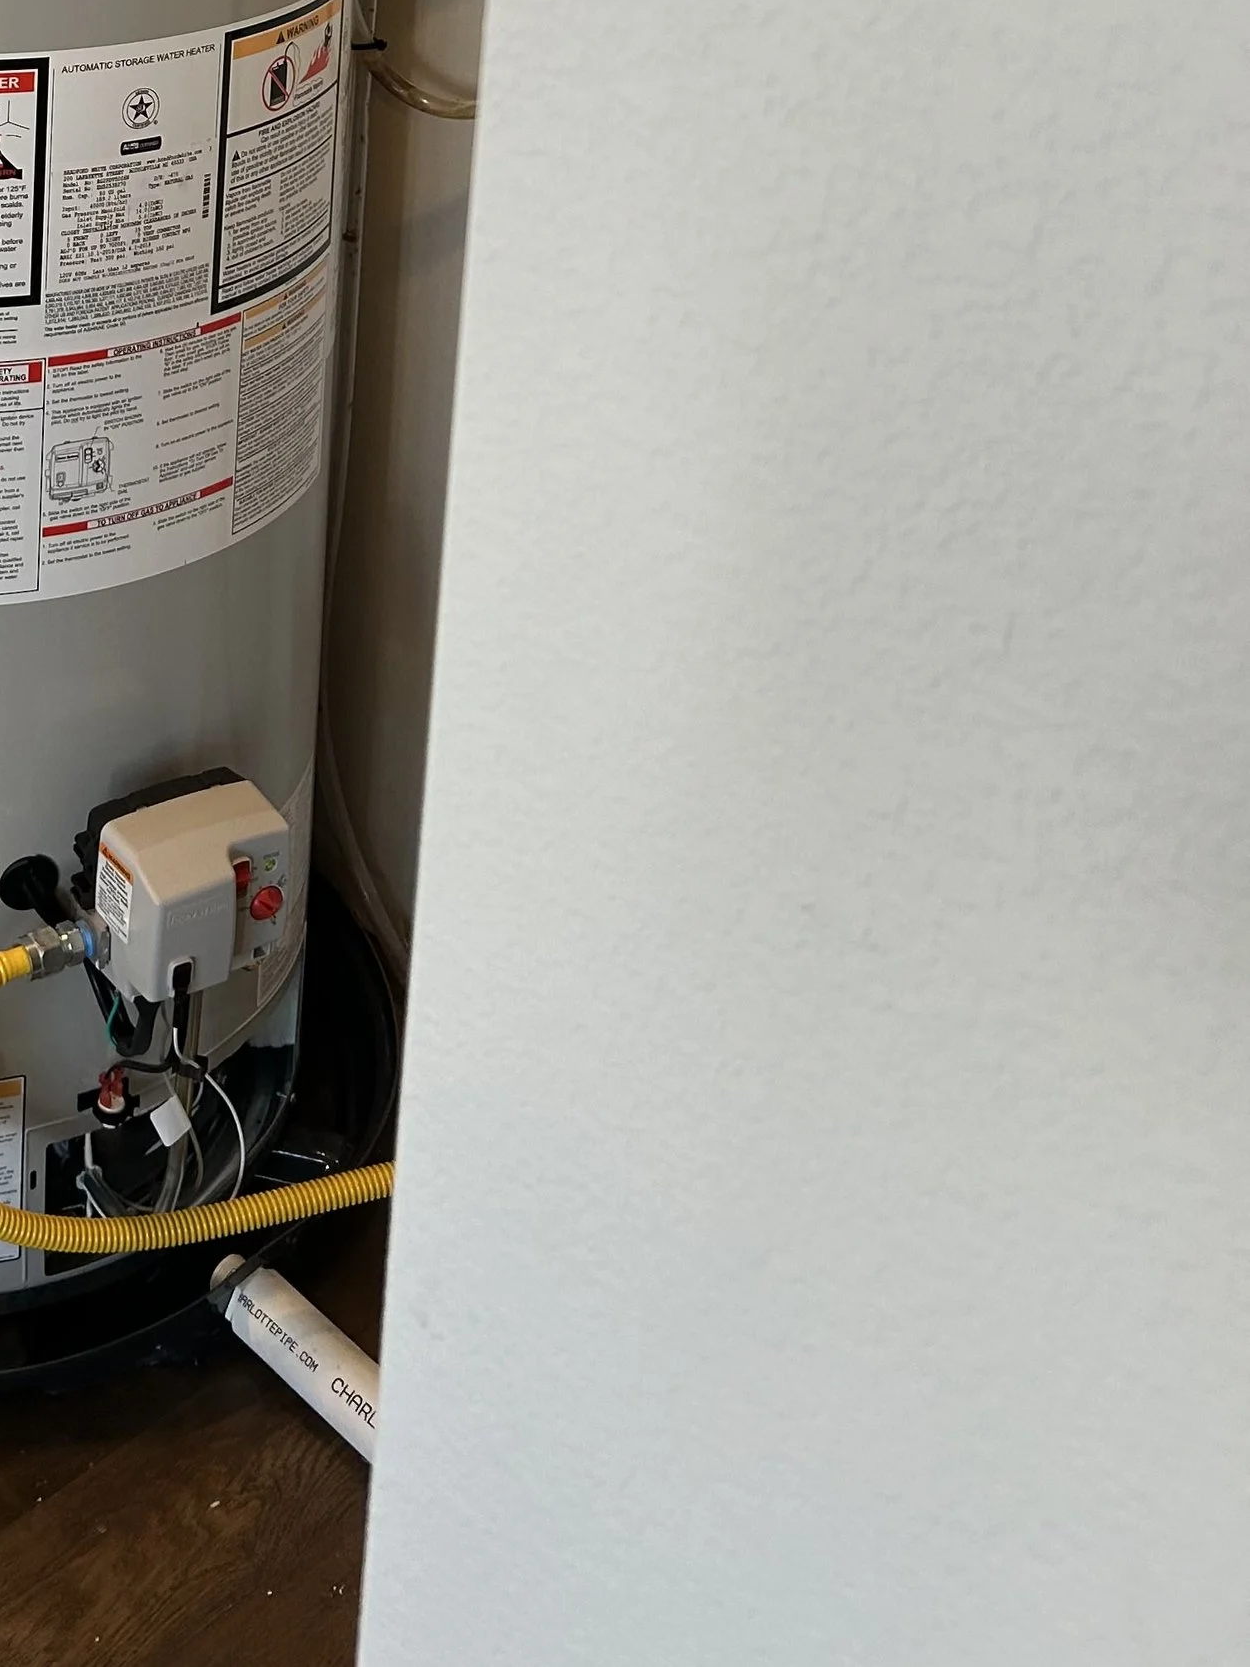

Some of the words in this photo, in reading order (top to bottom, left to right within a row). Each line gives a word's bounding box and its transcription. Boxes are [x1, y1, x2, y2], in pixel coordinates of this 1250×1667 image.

[286, 15, 319, 39] WARNING
[62, 61, 113, 74] AUTOMATIC
[115, 55, 154, 68] STORAGE
[157, 50, 184, 62] WATER
[186, 44, 215, 56] HEATER
[114, 341, 150, 356] OPERATING
[153, 331, 196, 348] INSTRUCTIONS
[98, 519, 106, 527] TO
[110, 515, 125, 524] TURN
[126, 512, 139, 521] OFF
[140, 507, 152, 517] GAS
[154, 505, 163, 513] TO
[165, 494, 196, 510] APPLIANCE
[330, 1377, 376, 1429] CHARL
